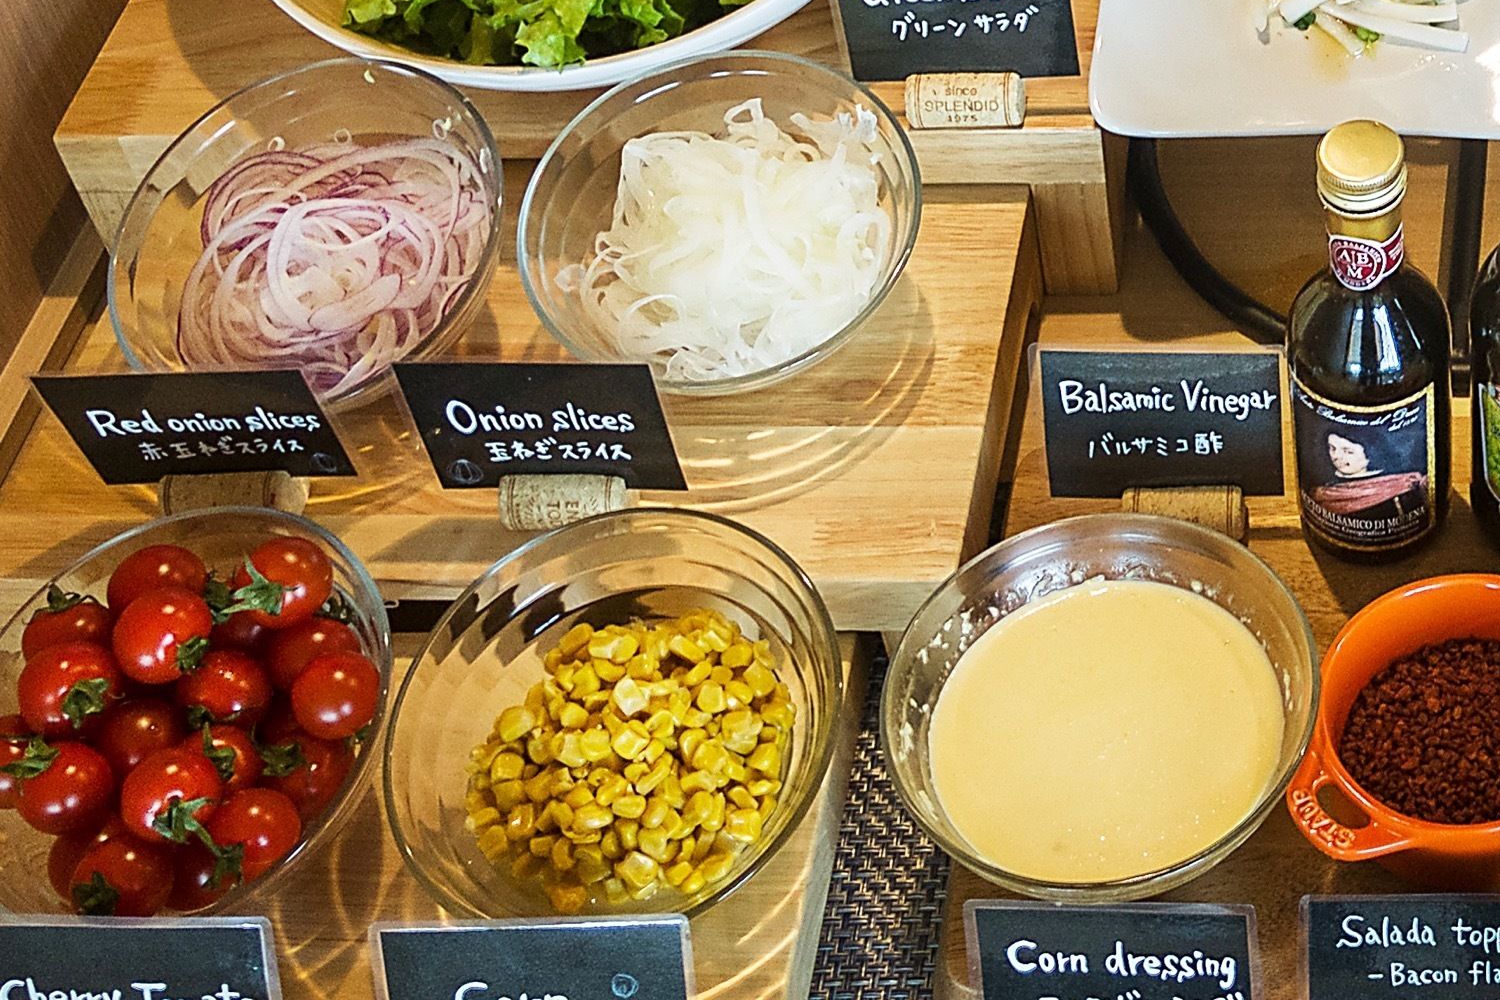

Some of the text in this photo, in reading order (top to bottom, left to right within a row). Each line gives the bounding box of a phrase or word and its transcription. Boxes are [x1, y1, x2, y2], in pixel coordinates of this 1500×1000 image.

[924, 100, 1000, 113] SPLENDID
[1058, 379, 1176, 415] Balsamic
[1180, 379, 1277, 421] Vinegar
[85, 406, 321, 439] Red onion slices
[445, 399, 636, 436] Onion slices
[137, 435, 305, 462] 赤玉ねぎスライス
[484, 436, 632, 462] 玉ねぎスライス
[1322, 507, 1373, 530] BALSAMICO
[1335, 914, 1437, 949] Salada
[1005, 939, 1237, 991] Corn dressing
